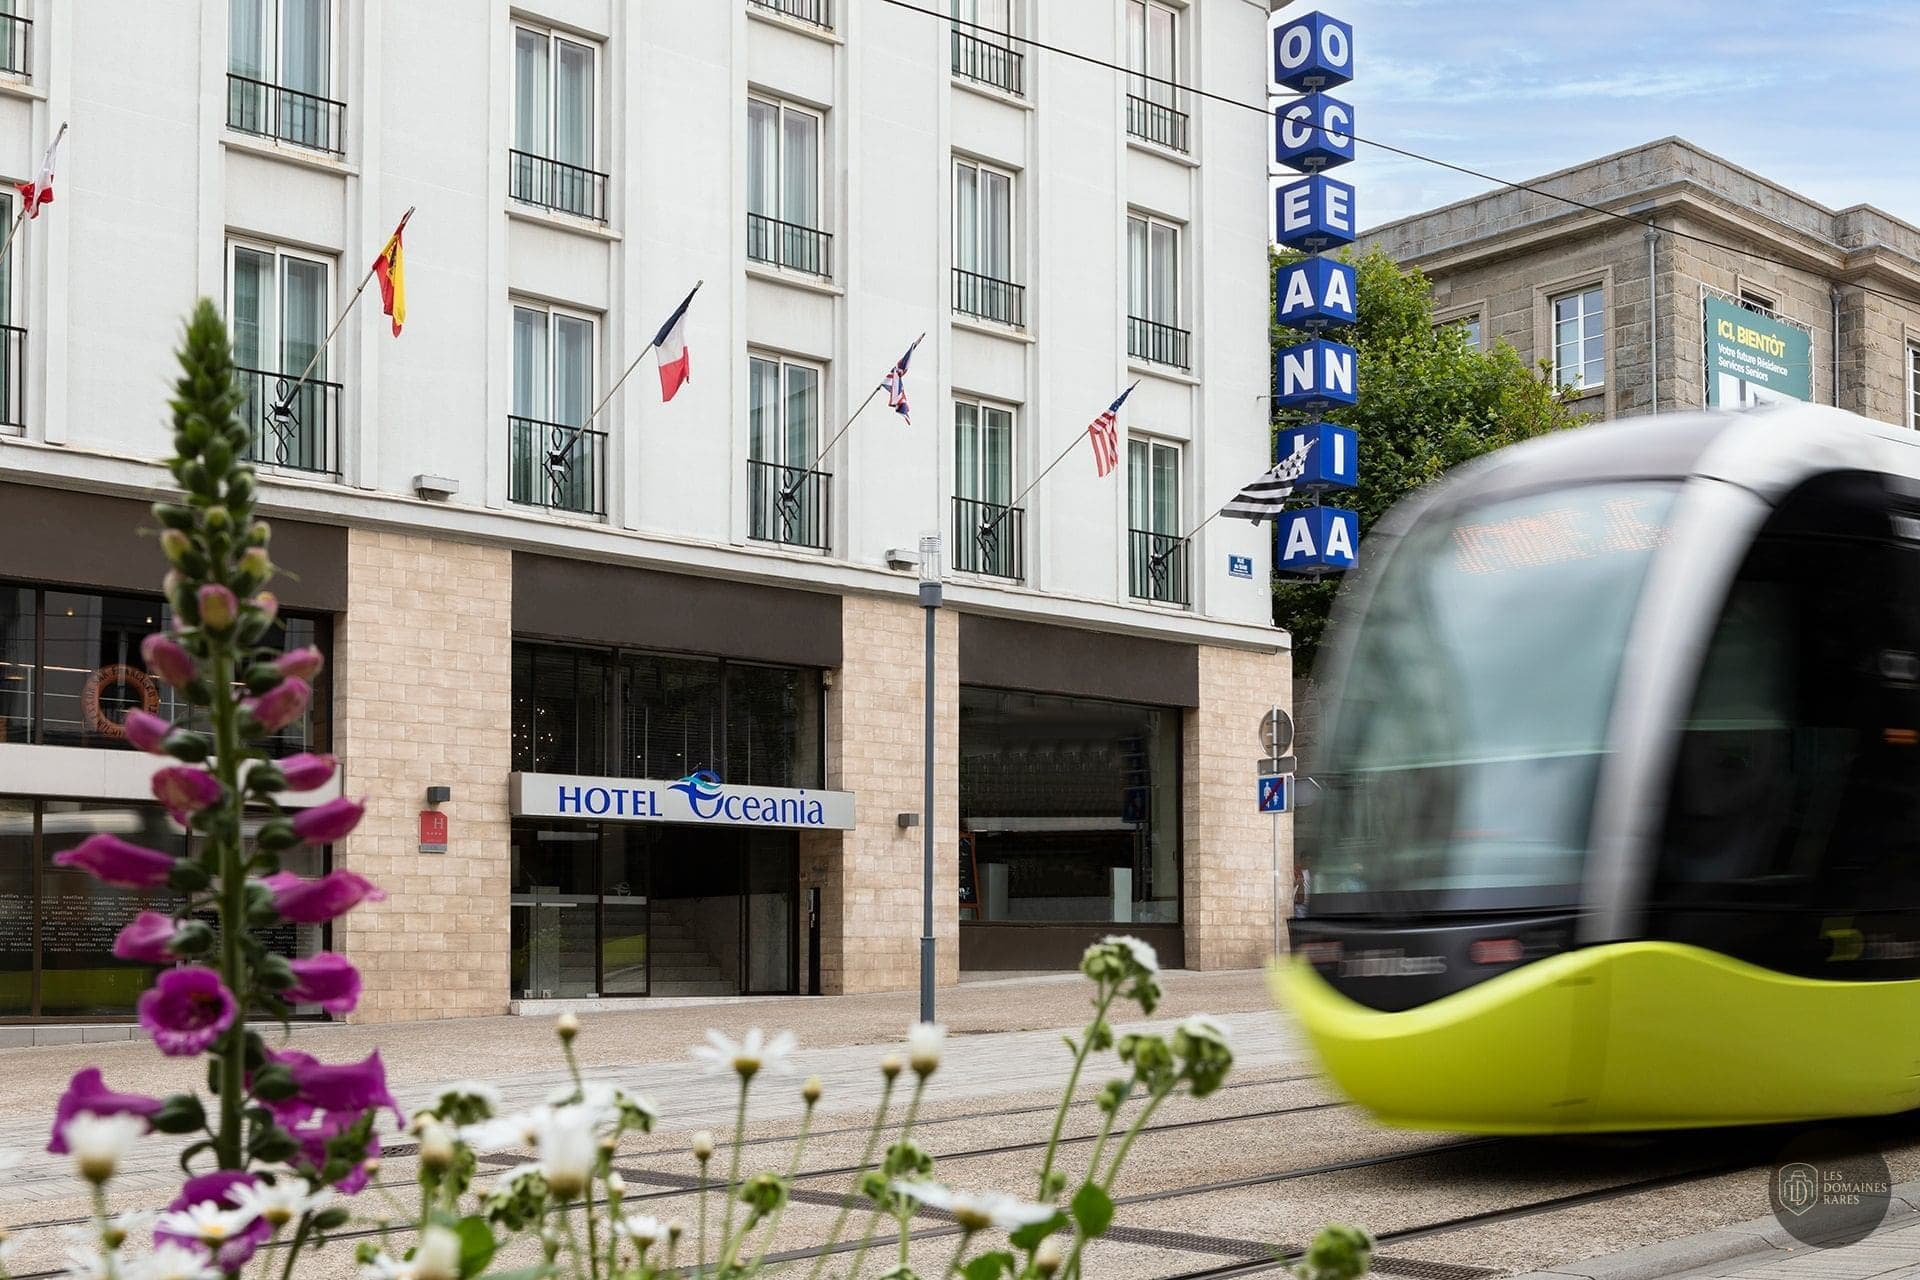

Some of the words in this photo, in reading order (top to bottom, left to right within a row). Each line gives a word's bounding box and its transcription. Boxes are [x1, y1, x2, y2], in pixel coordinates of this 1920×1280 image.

[1320, 24, 1354, 560] OCEANIA
[1717, 343, 1736, 357] Votre
[1736, 349, 1756, 366] future
[1718, 318, 1735, 342] ICI,
[1737, 325, 1786, 359] BIENTÔT
[1718, 356, 1745, 373] Services
[558, 785, 663, 817] HOTEL
[674, 769, 824, 825] Oceania
